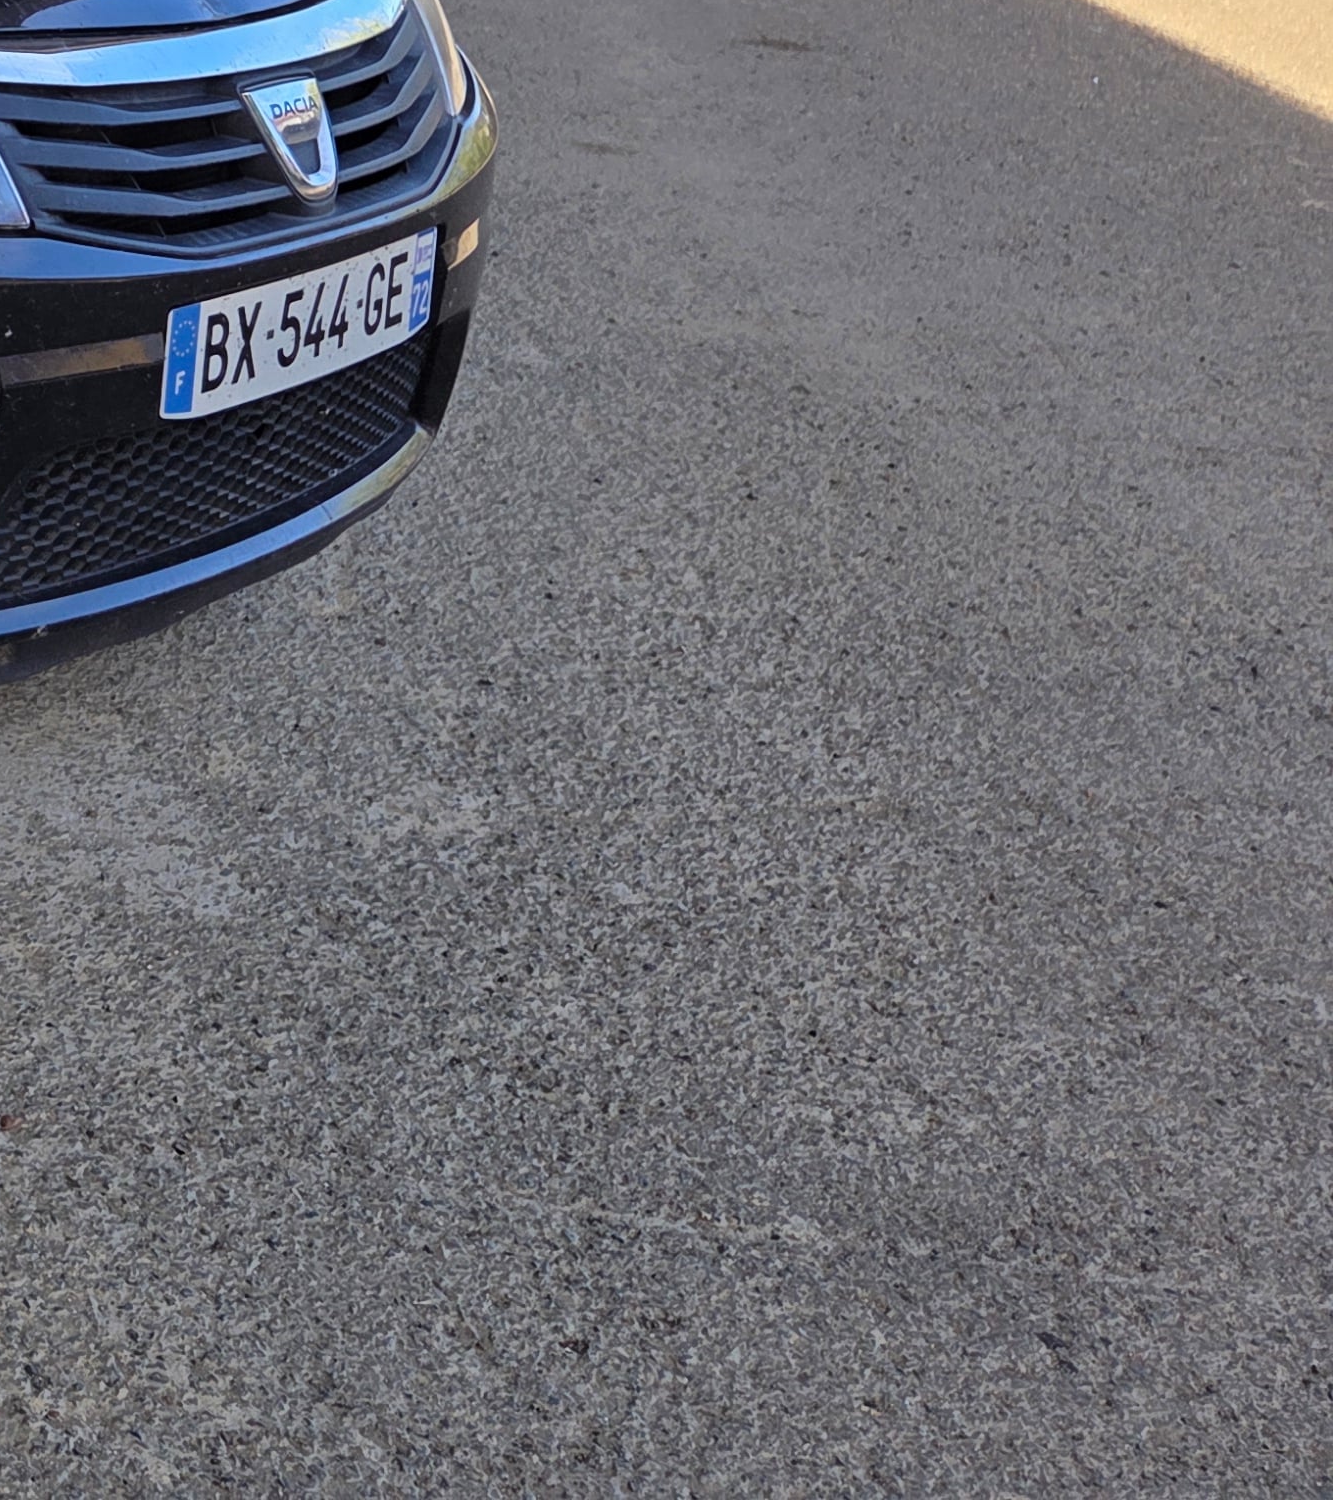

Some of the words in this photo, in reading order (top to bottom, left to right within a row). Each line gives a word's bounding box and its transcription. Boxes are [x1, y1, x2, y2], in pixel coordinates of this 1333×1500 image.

[269, 95, 319, 119] DACIA
[174, 370, 186, 395] F
[412, 279, 430, 318] 72
